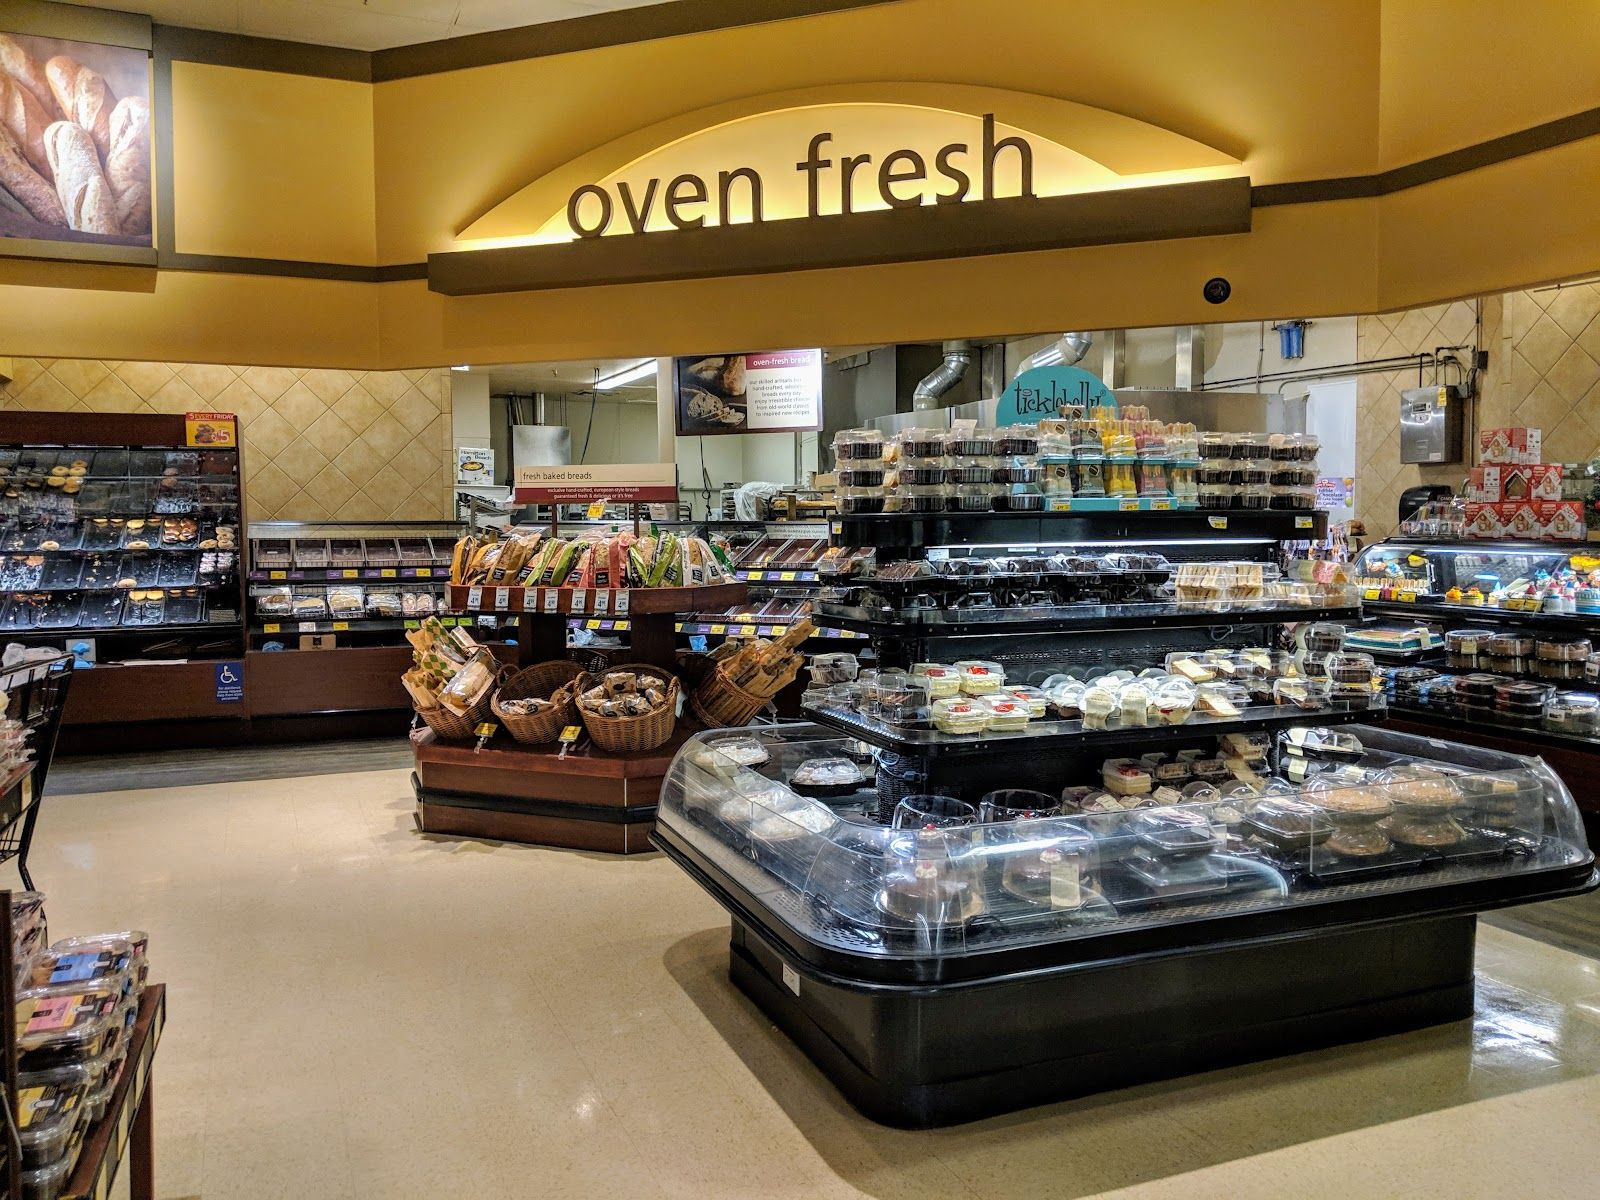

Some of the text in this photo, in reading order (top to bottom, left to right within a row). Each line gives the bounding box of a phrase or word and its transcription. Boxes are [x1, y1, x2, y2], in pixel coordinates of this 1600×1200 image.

[566, 113, 1037, 238] oven fresh
[753, 356, 810, 366] oven-fresh bread
[523, 471, 592, 480] fresh baked breads
